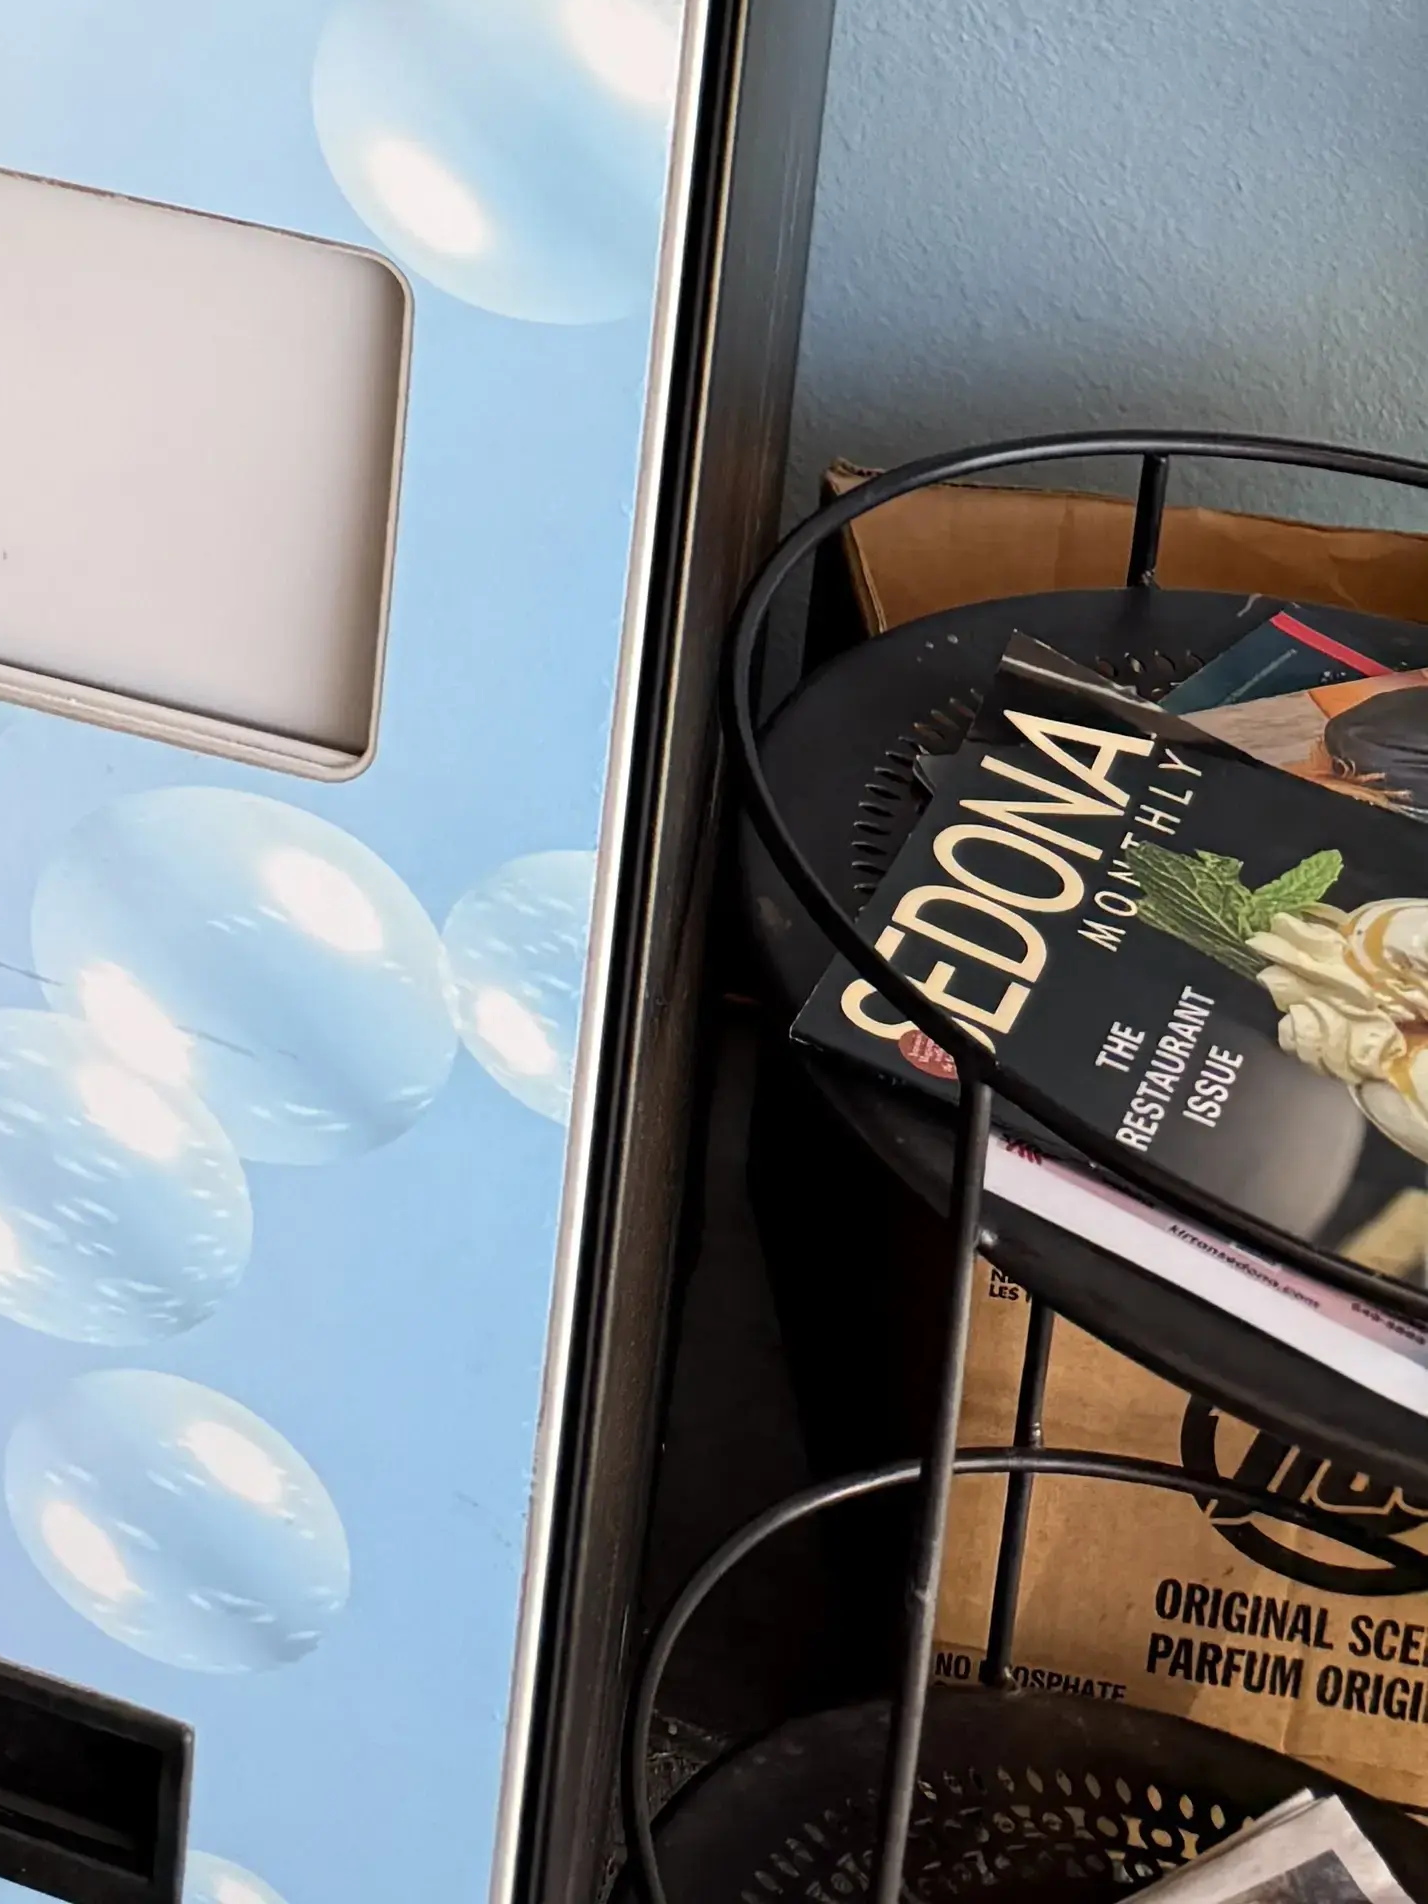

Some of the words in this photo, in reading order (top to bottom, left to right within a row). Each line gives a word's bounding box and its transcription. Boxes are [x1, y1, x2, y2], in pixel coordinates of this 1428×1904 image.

[840, 707, 1154, 1054] SEDONA
[1095, 1020, 1145, 1074] THE
[1115, 984, 1216, 1151] RESTAURANT
[1182, 1045, 1244, 1128] ISSUE
[989, 1285, 1020, 1301] LES
[935, 1652, 972, 1680] NO
[1155, 1578, 1334, 1650] ORIGINAL
[1348, 1614, 1428, 1668] SCE
[1147, 1632, 1304, 1699] PARFUM
[1316, 1665, 1428, 1724] ORIGI
